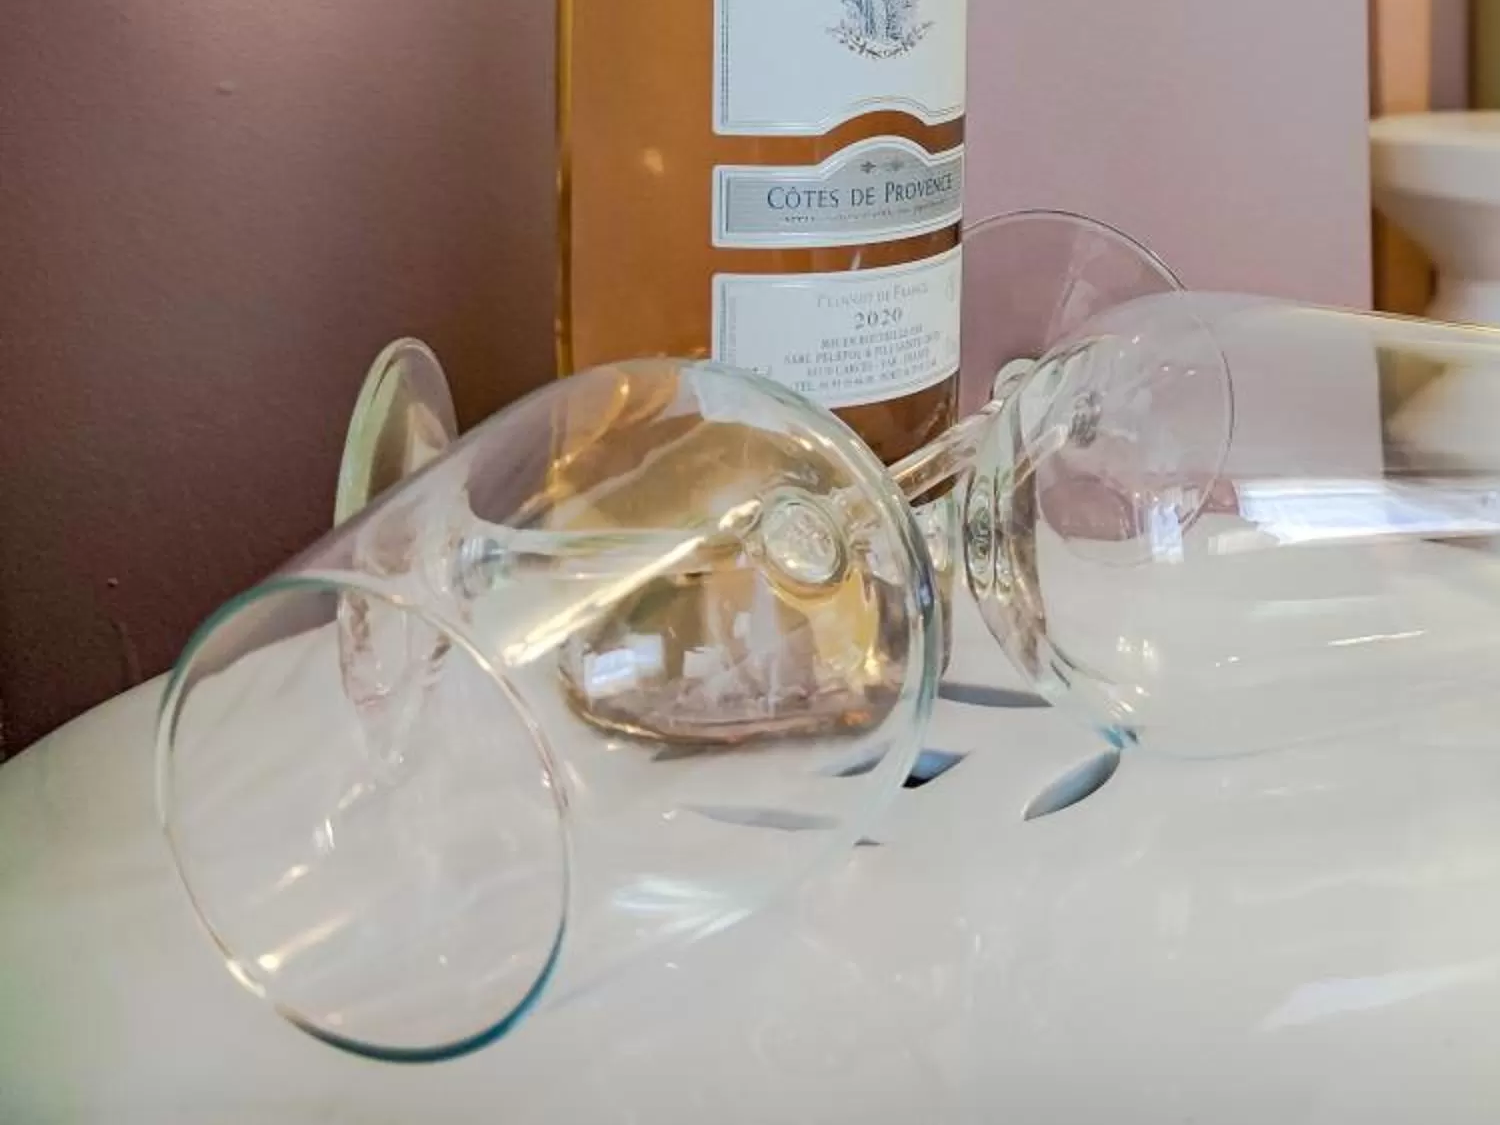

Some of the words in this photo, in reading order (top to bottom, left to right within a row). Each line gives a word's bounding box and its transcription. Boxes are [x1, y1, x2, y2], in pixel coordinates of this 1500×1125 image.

[767, 186, 840, 210] CÔTES
[851, 187, 876, 207] DE
[884, 173, 953, 204] PROVENCE
[854, 307, 904, 330] 2020
